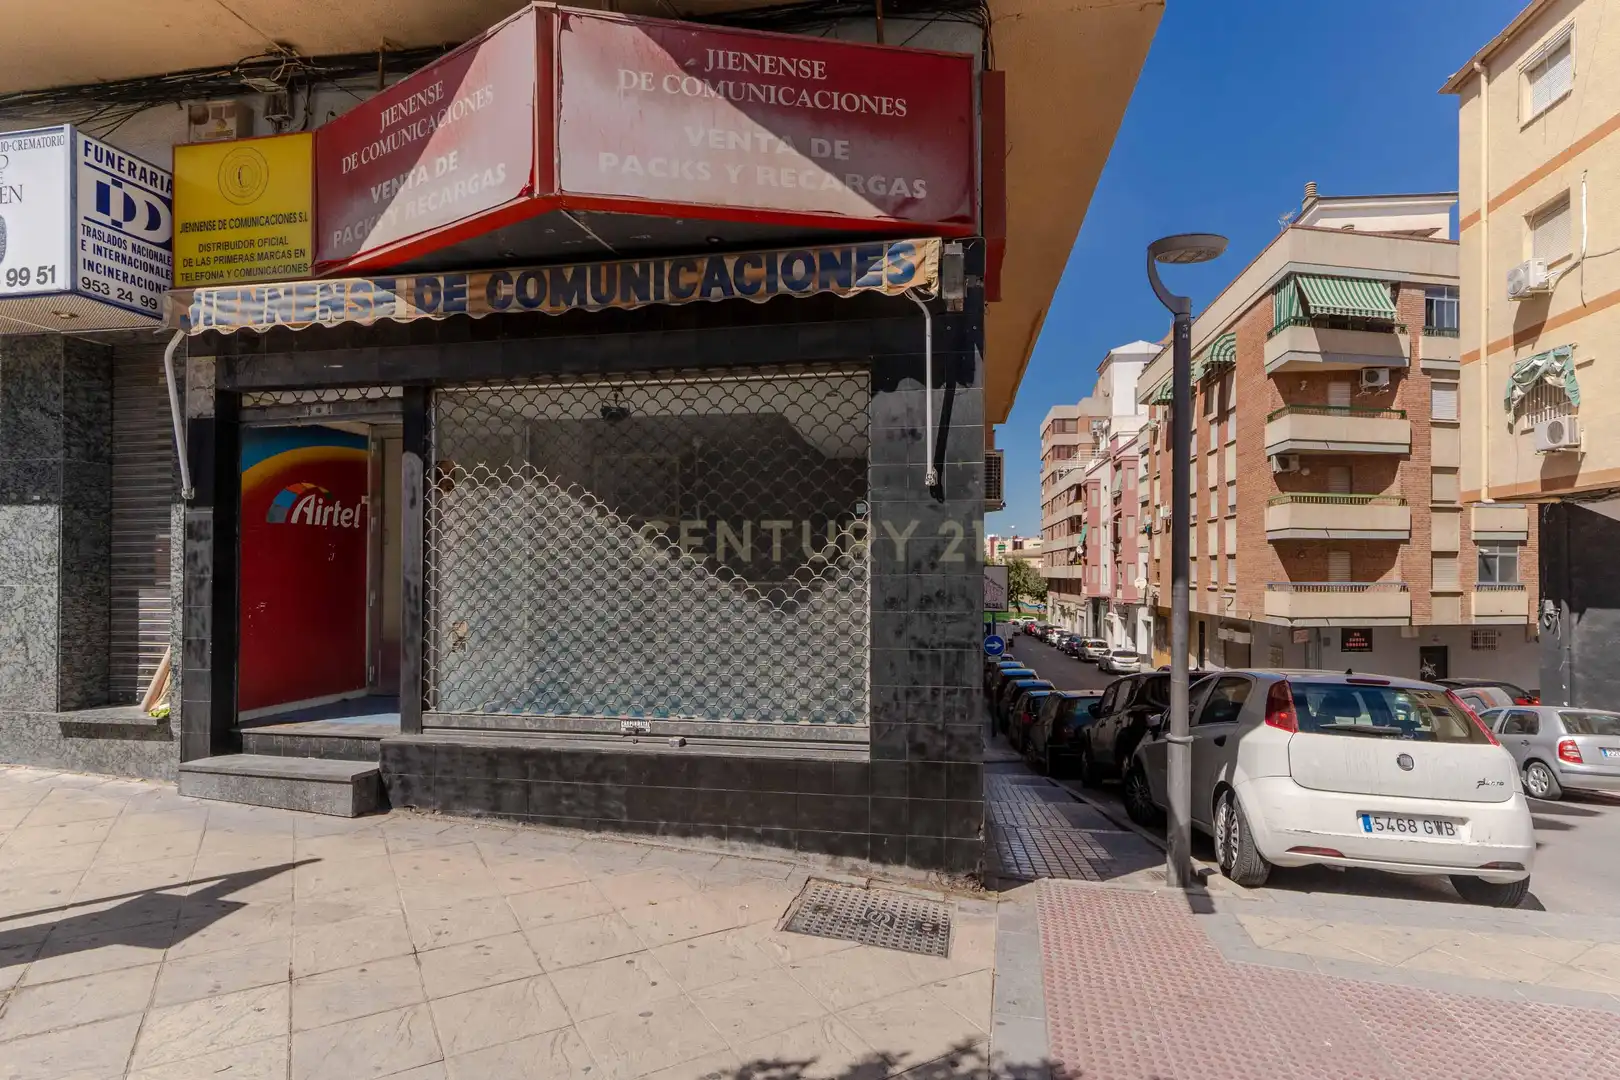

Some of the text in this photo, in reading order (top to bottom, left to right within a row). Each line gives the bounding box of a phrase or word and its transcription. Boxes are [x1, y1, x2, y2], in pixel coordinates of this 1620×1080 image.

[704, 48, 828, 81] JIENENSE
[380, 79, 445, 133] JIENENSE
[617, 68, 908, 117] DE COMUNICACIONES
[341, 84, 493, 175] DE COMUNICACIONES
[684, 125, 850, 160] VENTA DE
[84, 139, 172, 194] FUNERARIA
[370, 150, 459, 203] VENTA DE
[598, 151, 927, 199] PACKS Y RECARGAS
[0, 184, 23, 204] EN
[332, 162, 507, 249] PACKS Y RECARGAS
[218, 219, 227, 230] DE
[228, 212, 297, 230] COMUNICACIONES
[81, 223, 172, 267] TRASLADOS NACIONALE
[81, 239, 173, 281] E INTERNACIONALE
[183, 248, 306, 268] DE LAS PRIMERAS MARCAS EN
[198, 236, 289, 253] DISTRIBUIDOR OFICIAL
[6, 264, 56, 287] 99 51
[82, 258, 173, 295] INCINERACIONE
[226, 268, 234, 279] Y
[233, 263, 308, 278] COMUNICACIONES
[413, 274, 470, 313] DE
[486, 242, 917, 312] COMUNICACIONES
[81, 276, 158, 310] 953 24 99
[290, 493, 361, 529] Airtel
[1373, 816, 1456, 837] 5468 GWB
